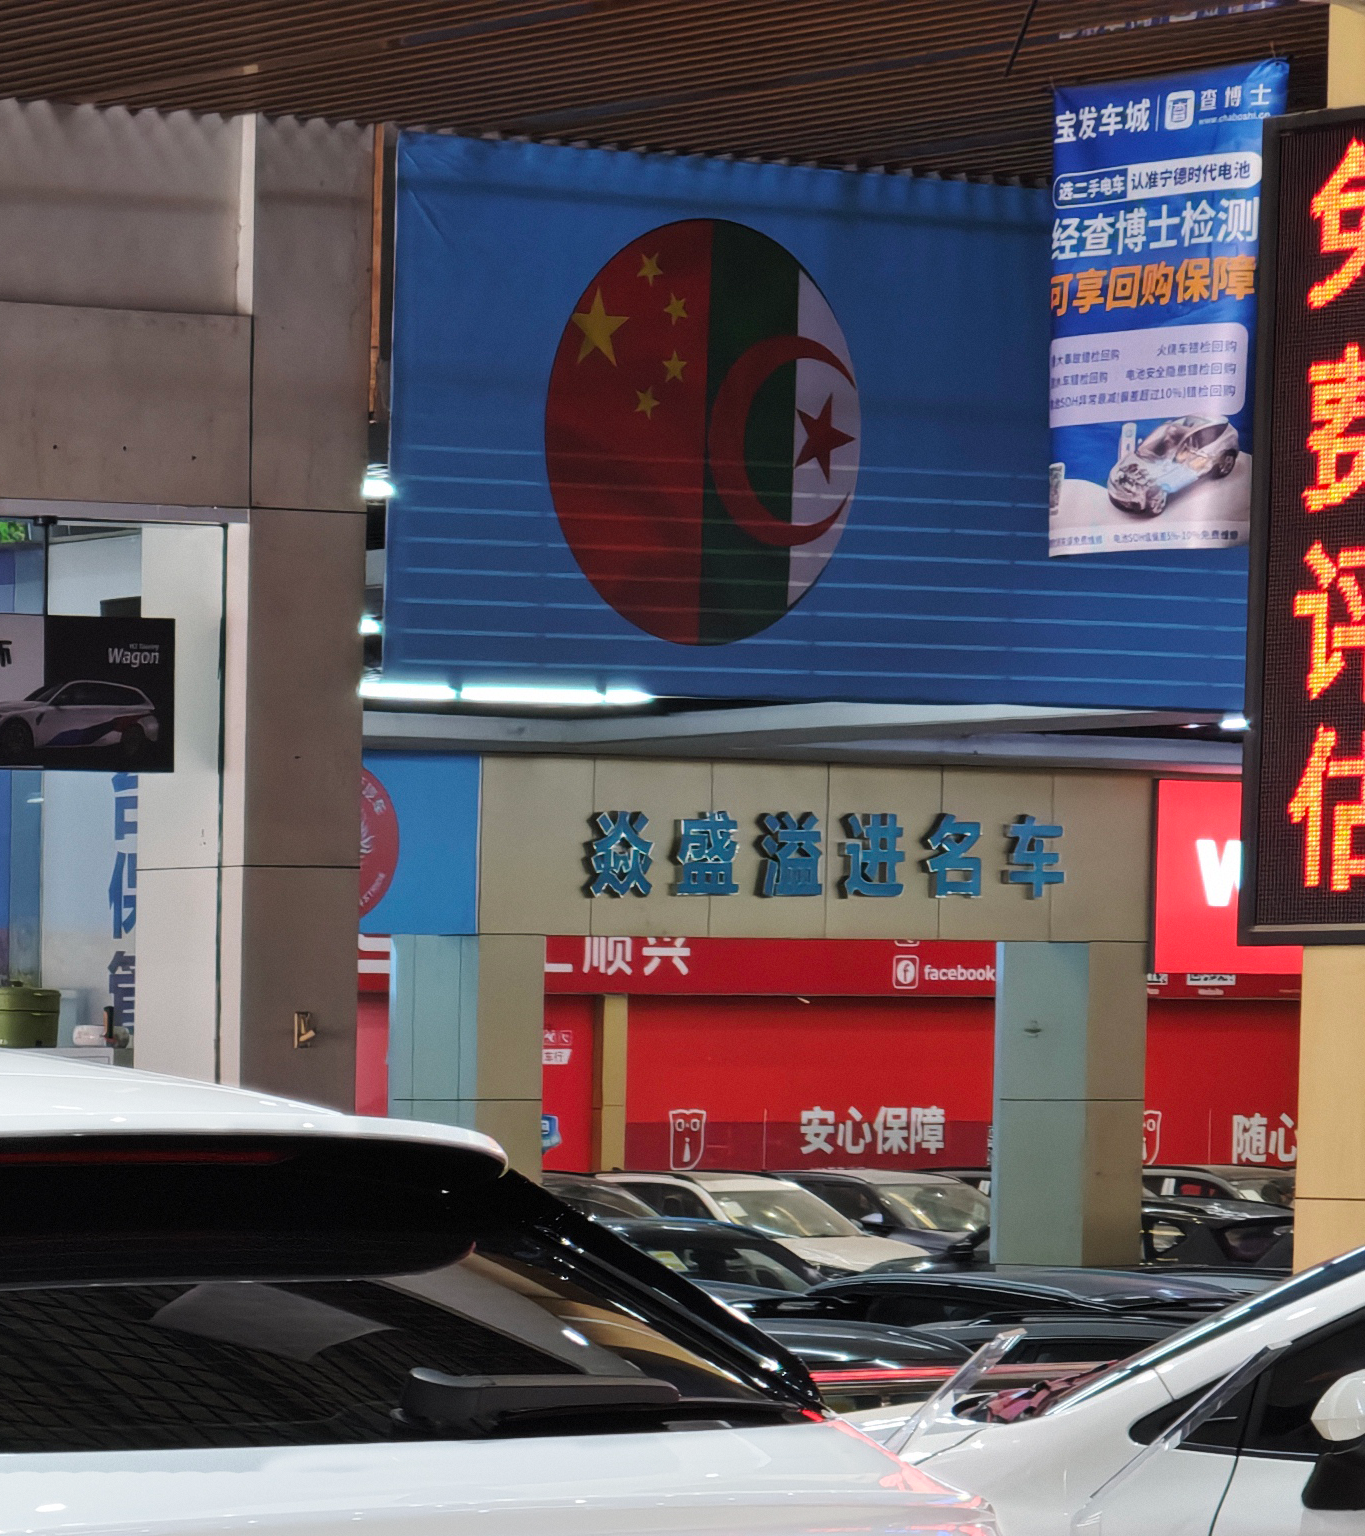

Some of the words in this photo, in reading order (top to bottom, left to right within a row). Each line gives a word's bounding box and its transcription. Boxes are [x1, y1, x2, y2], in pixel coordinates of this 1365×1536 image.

[1199, 83, 1272, 112] 查博士
[1053, 98, 1151, 144] 宝发车城
[1058, 174, 1126, 201] 选二手电车
[1130, 160, 1251, 190] 认准宁德时代电池
[1051, 196, 1260, 260] 经查博士检测
[1051, 254, 1257, 316] 可享回购保障
[107, 647, 160, 668] Wagon
[923, 962, 997, 982] facebook
[799, 1106, 946, 1156] 安心保障
